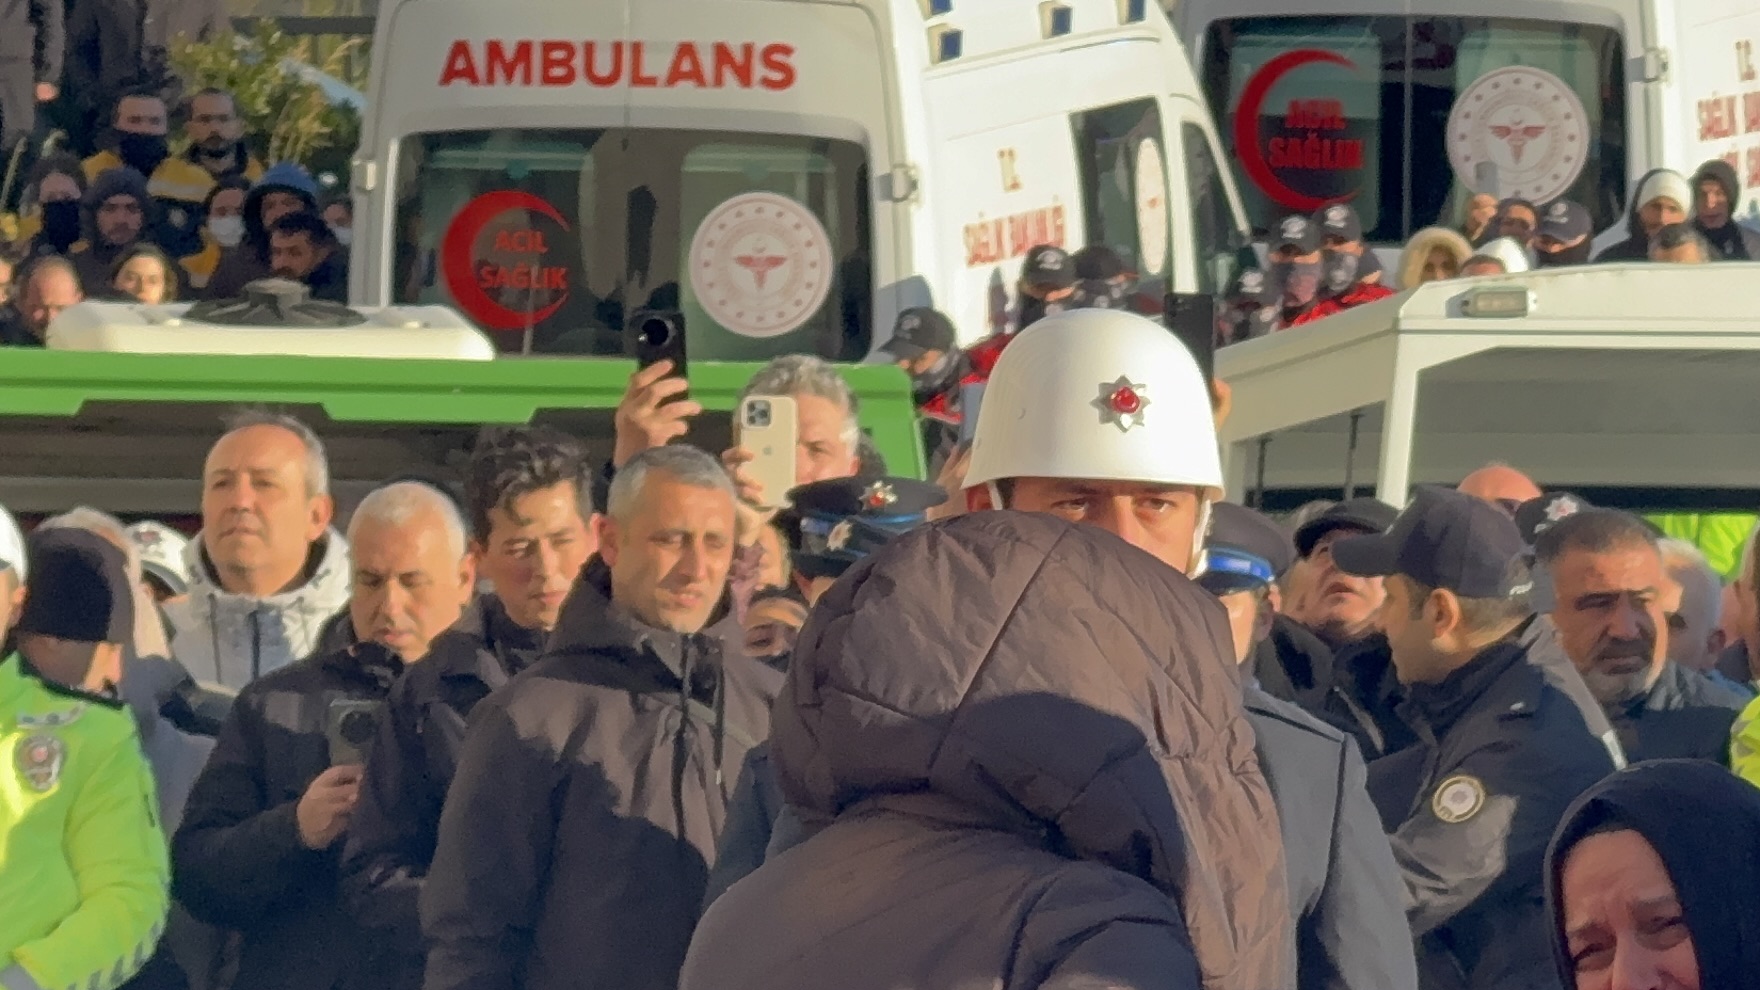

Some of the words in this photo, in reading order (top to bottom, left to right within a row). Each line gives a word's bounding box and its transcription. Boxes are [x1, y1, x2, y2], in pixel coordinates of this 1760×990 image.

[438, 38, 797, 92] AMBULANS
[1268, 130, 1365, 169] SAĞLIK
[480, 262, 567, 289] SAĞLIK
